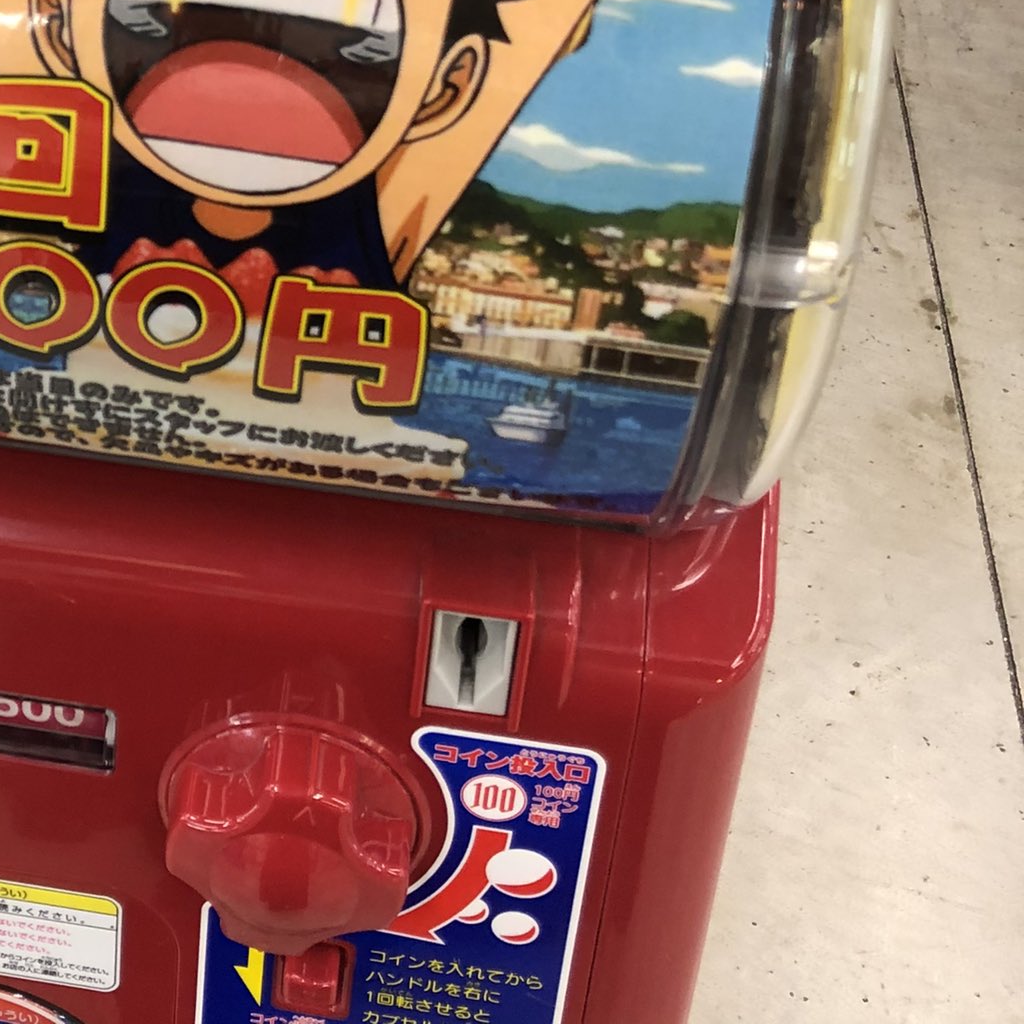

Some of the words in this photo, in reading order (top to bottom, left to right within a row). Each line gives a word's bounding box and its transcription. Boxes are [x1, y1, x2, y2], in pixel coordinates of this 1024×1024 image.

[433, 743, 592, 784] コイン投入口
[470, 782, 517, 813] 100
[368, 949, 544, 991] コインを入れてから
[364, 971, 501, 1005] ハンドルを右に
[365, 989, 491, 1023] 1回転させると
